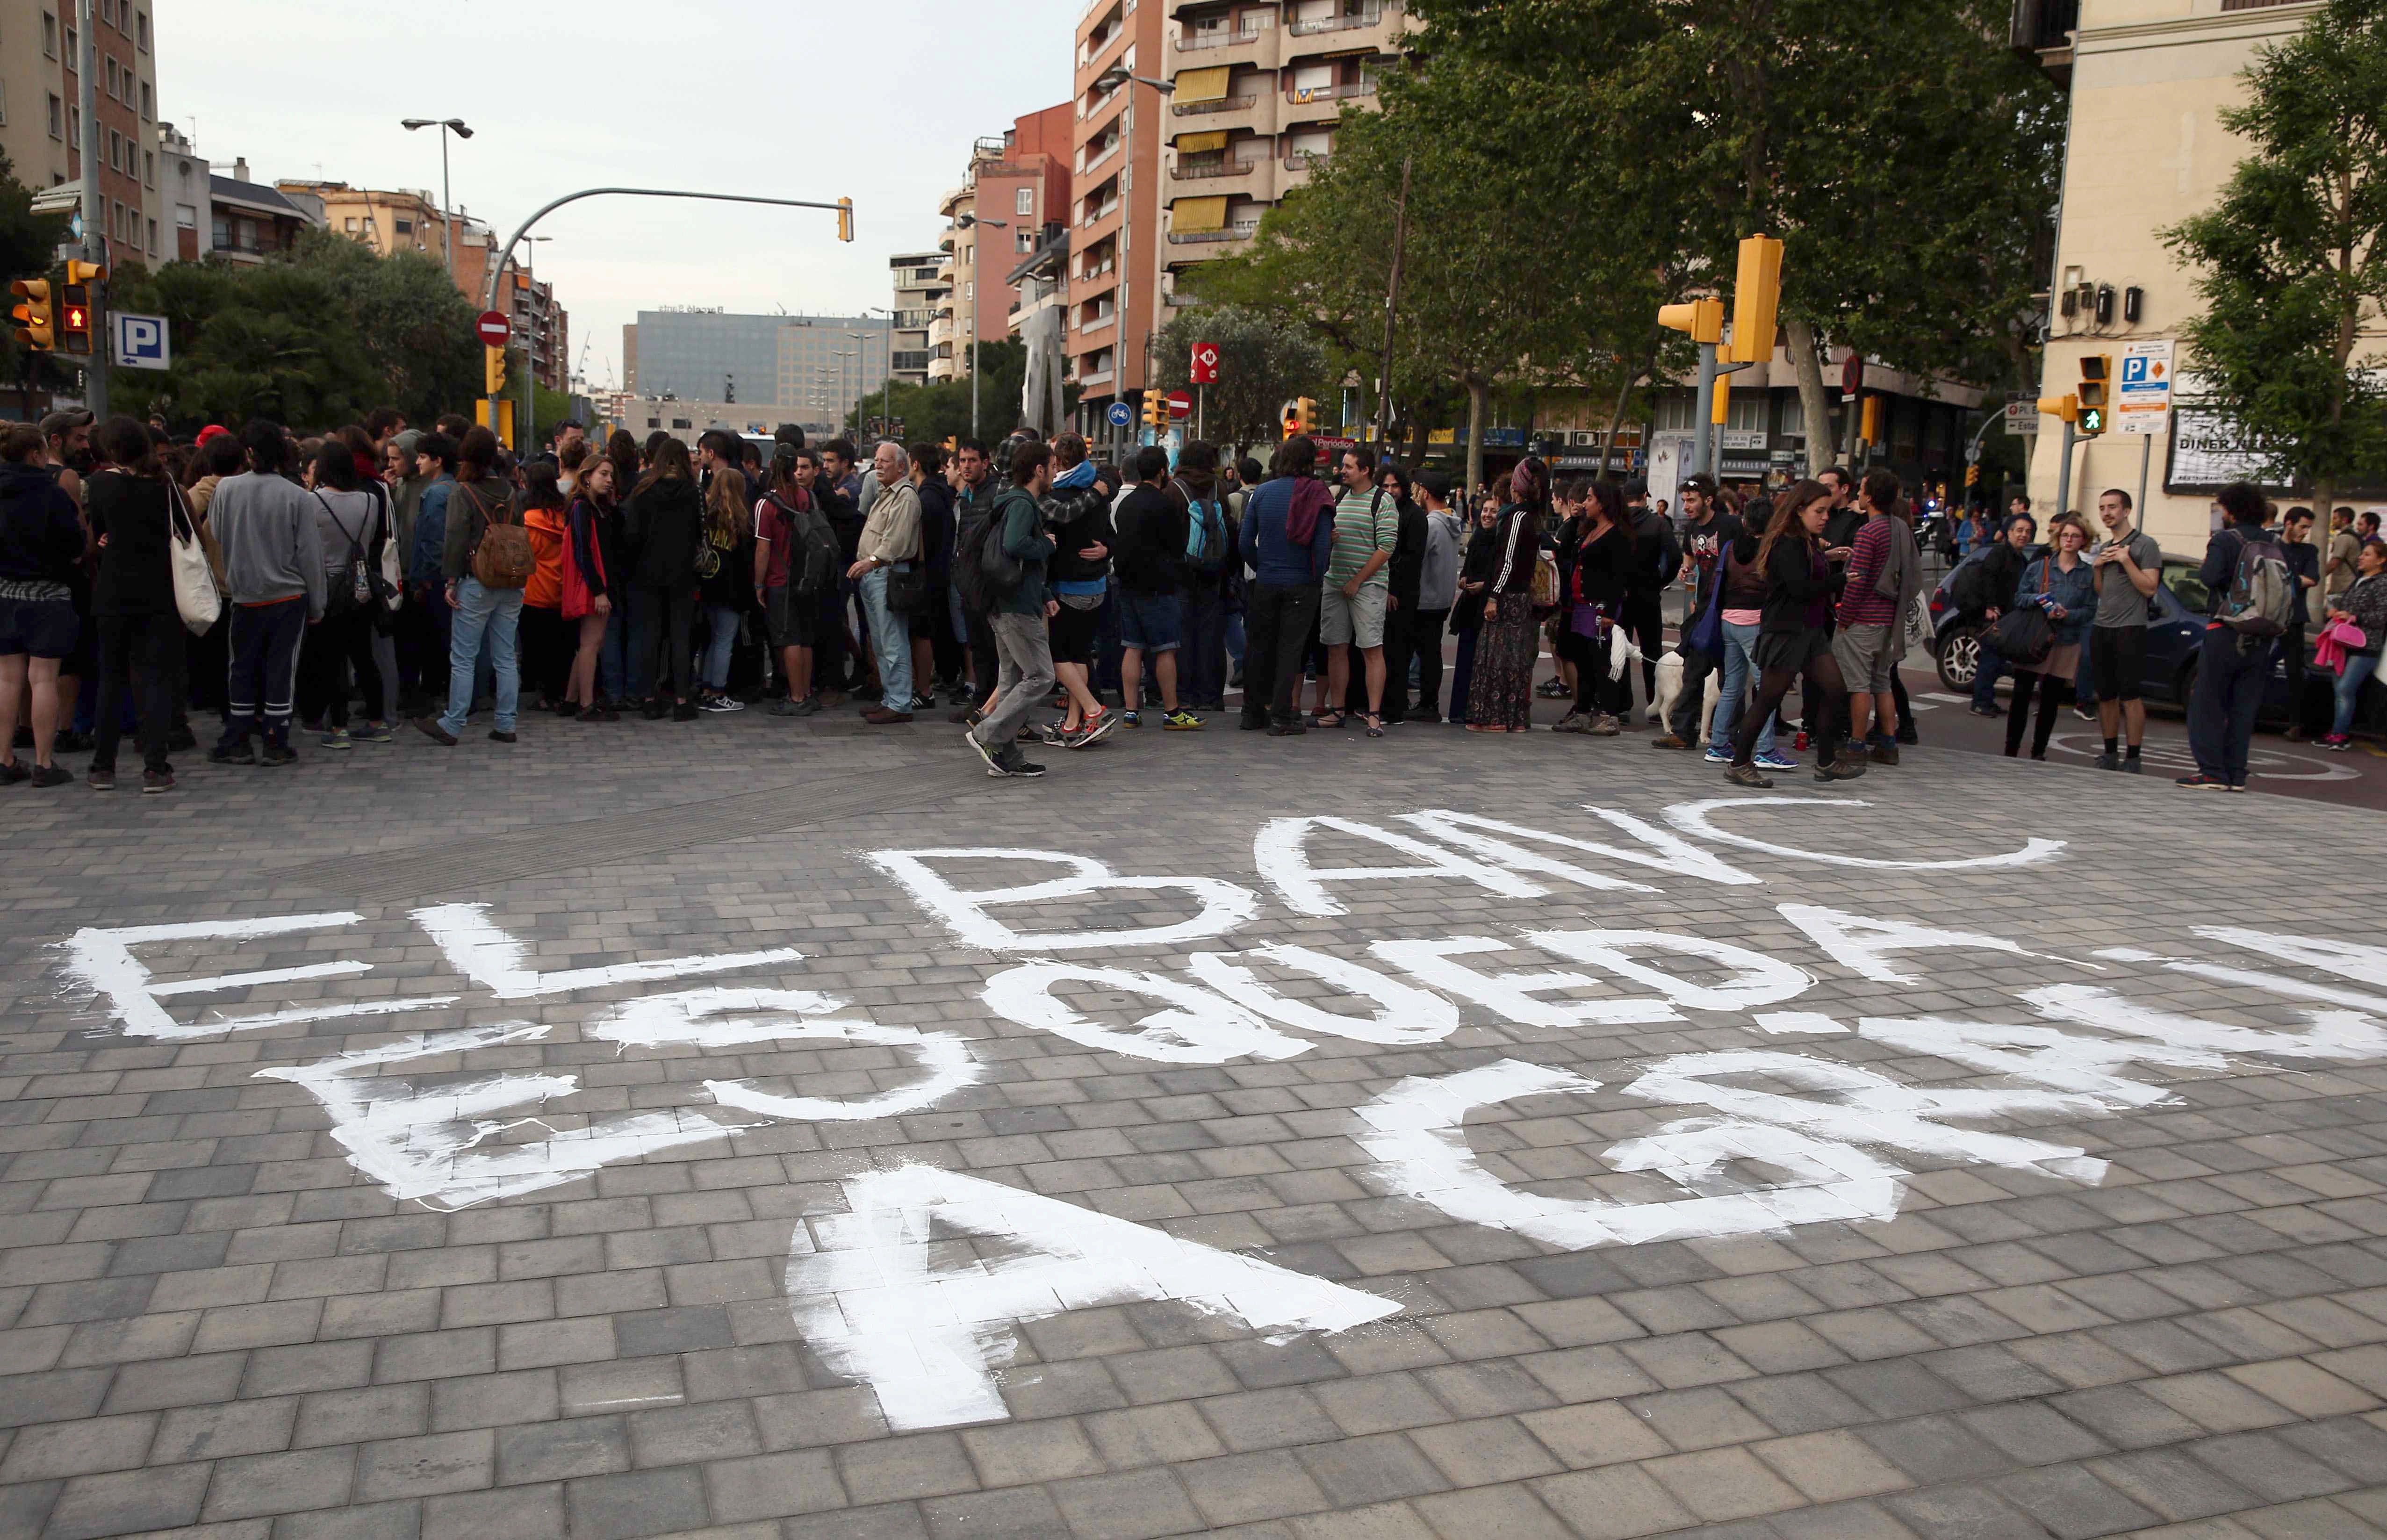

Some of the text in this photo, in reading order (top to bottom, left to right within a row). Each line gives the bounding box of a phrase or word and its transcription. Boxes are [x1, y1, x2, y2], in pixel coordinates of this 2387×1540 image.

[125, 319, 158, 355] P
[1206, 353, 1213, 362] M
[2127, 359, 2143, 381] P
[1317, 439, 1354, 449] Periódico
[2179, 439, 2229, 449] DINER
[51, 797, 2068, 1039] EL BANC
[252, 903, 2107, 1212] ES QUEDA
[785, 1162, 1405, 1429] A
